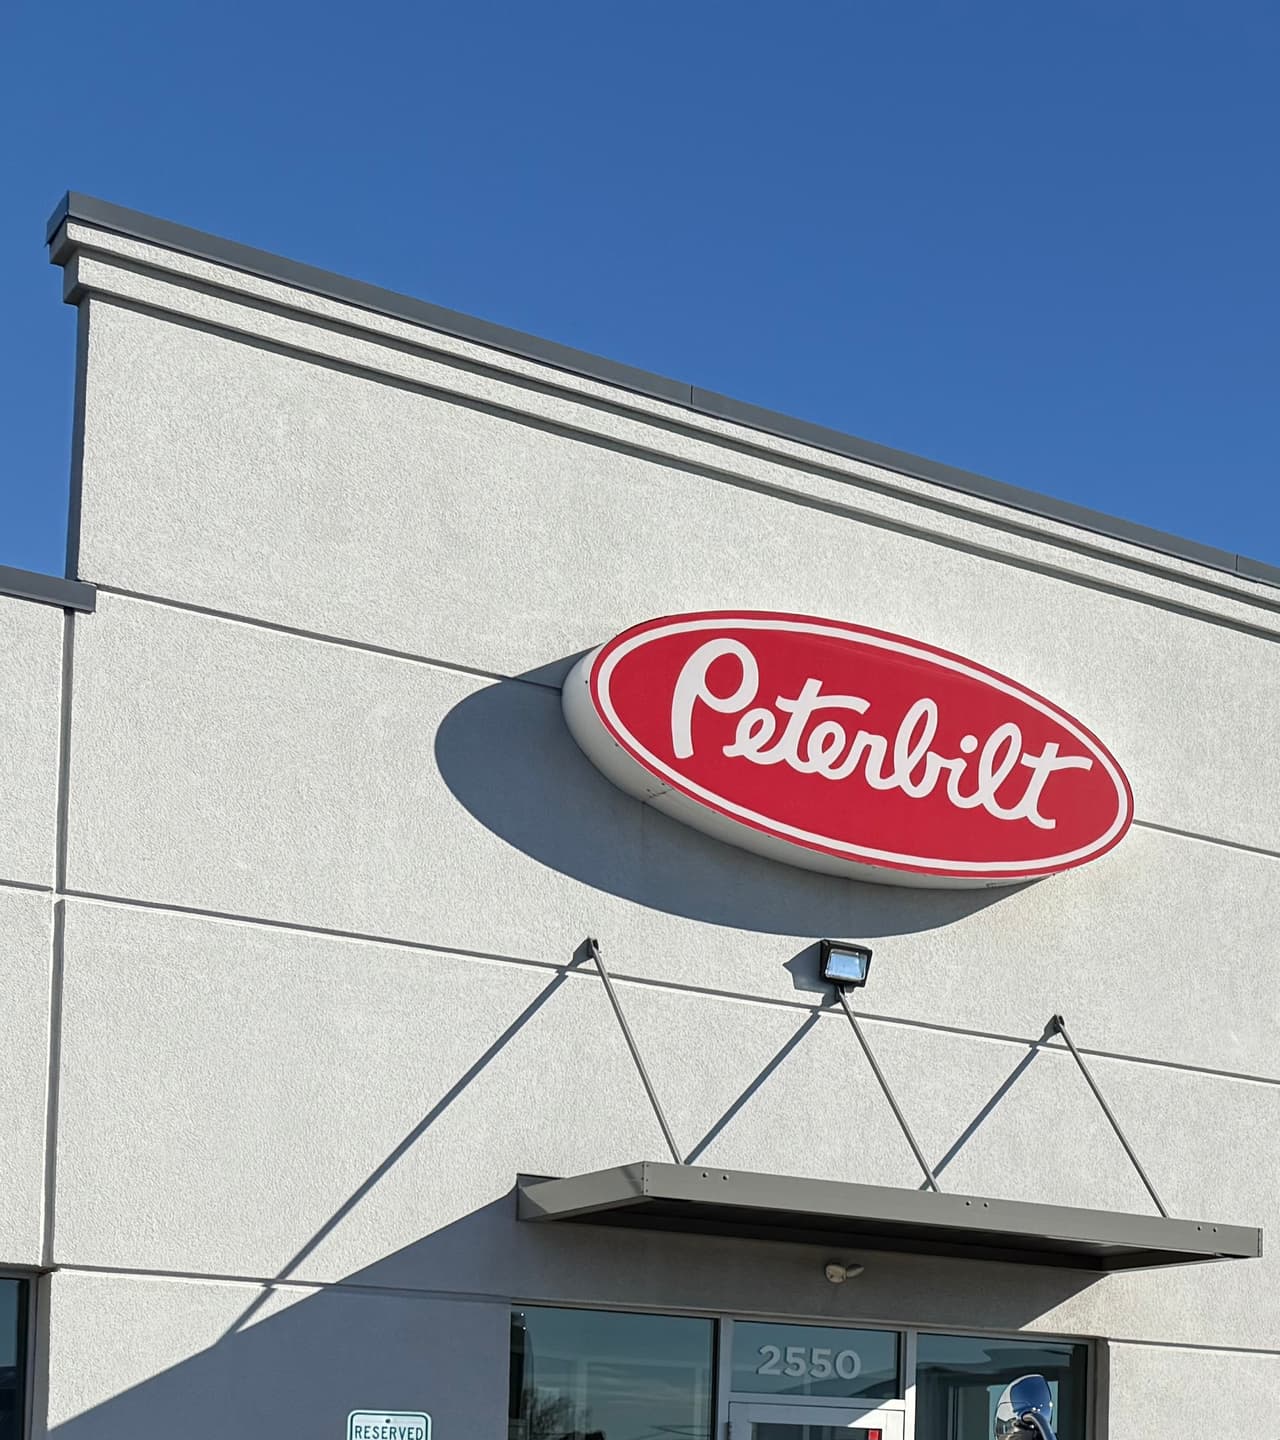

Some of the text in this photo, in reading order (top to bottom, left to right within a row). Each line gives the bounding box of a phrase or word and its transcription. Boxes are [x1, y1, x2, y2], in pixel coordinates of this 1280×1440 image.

[671, 637, 1093, 830] Peterbilt
[757, 1344, 862, 1380] 2550
[354, 1425, 424, 1440] RESERVED
